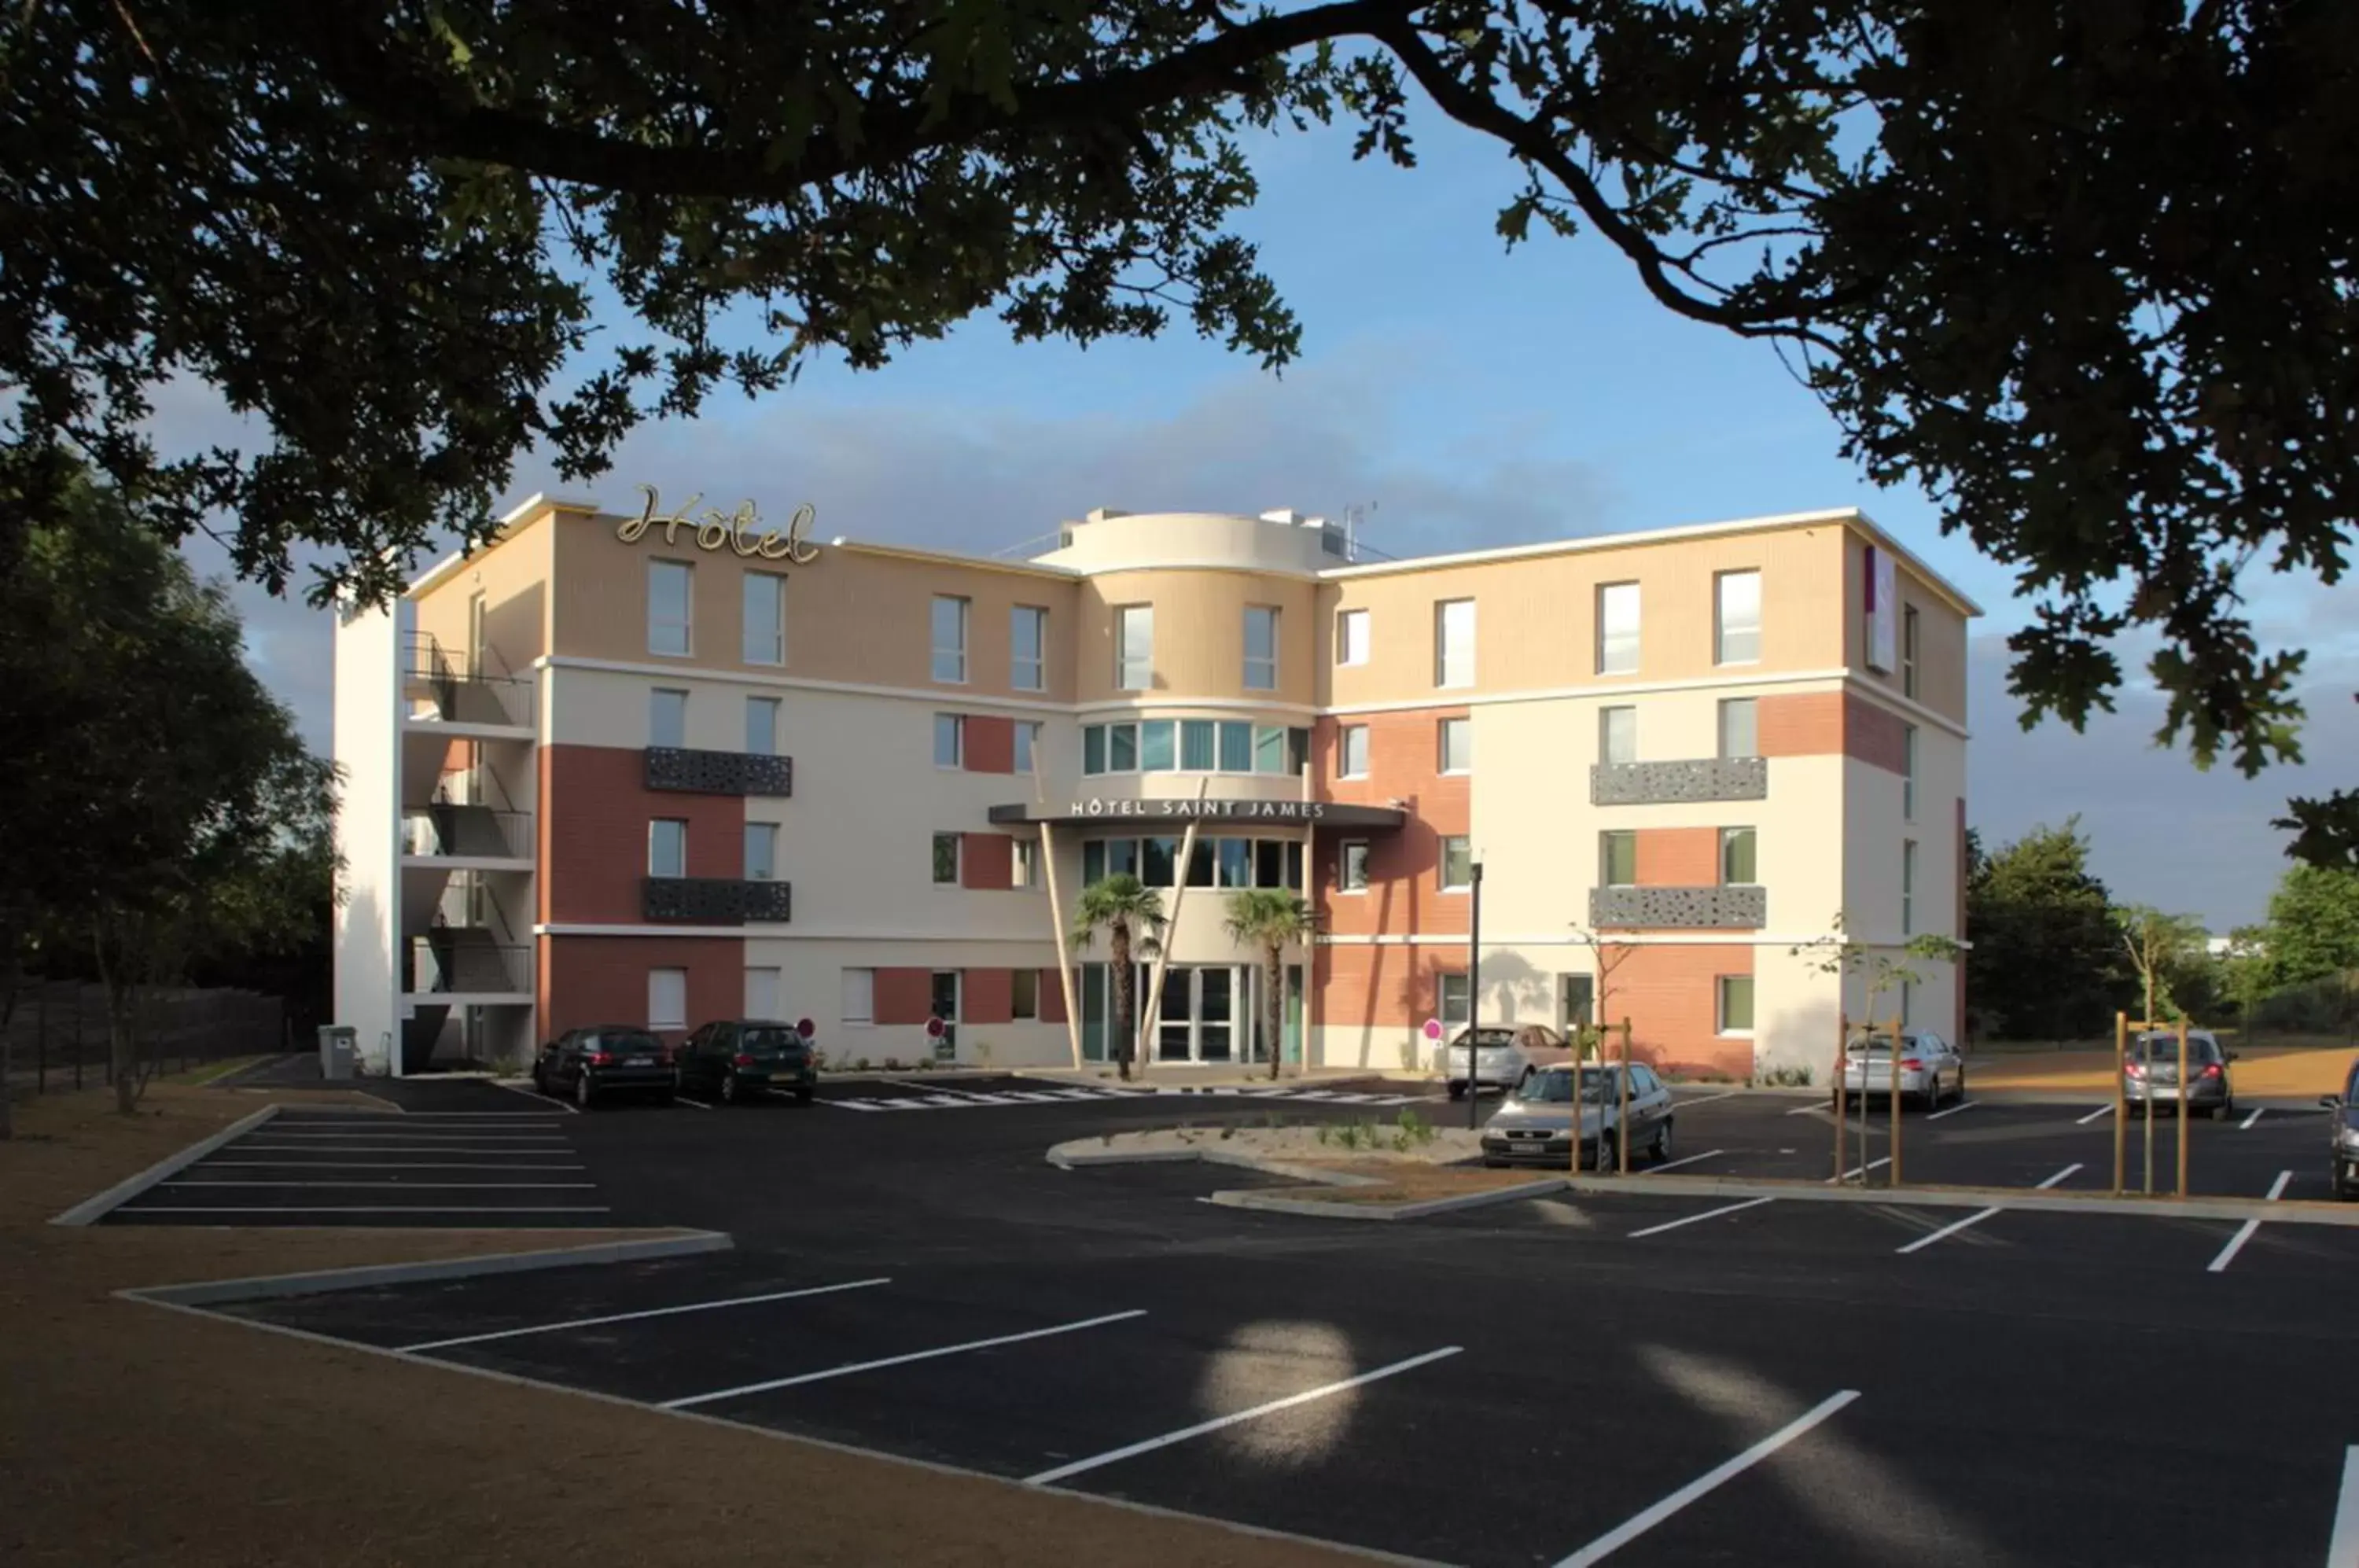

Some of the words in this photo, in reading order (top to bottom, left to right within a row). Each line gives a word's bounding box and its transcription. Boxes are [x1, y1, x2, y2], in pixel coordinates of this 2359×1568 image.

[616, 484, 819, 564] Hôtel
[1071, 799, 1146, 815] HÔTEL
[1162, 800, 1235, 815] SAINT
[1249, 801, 1324, 818] JAMES
